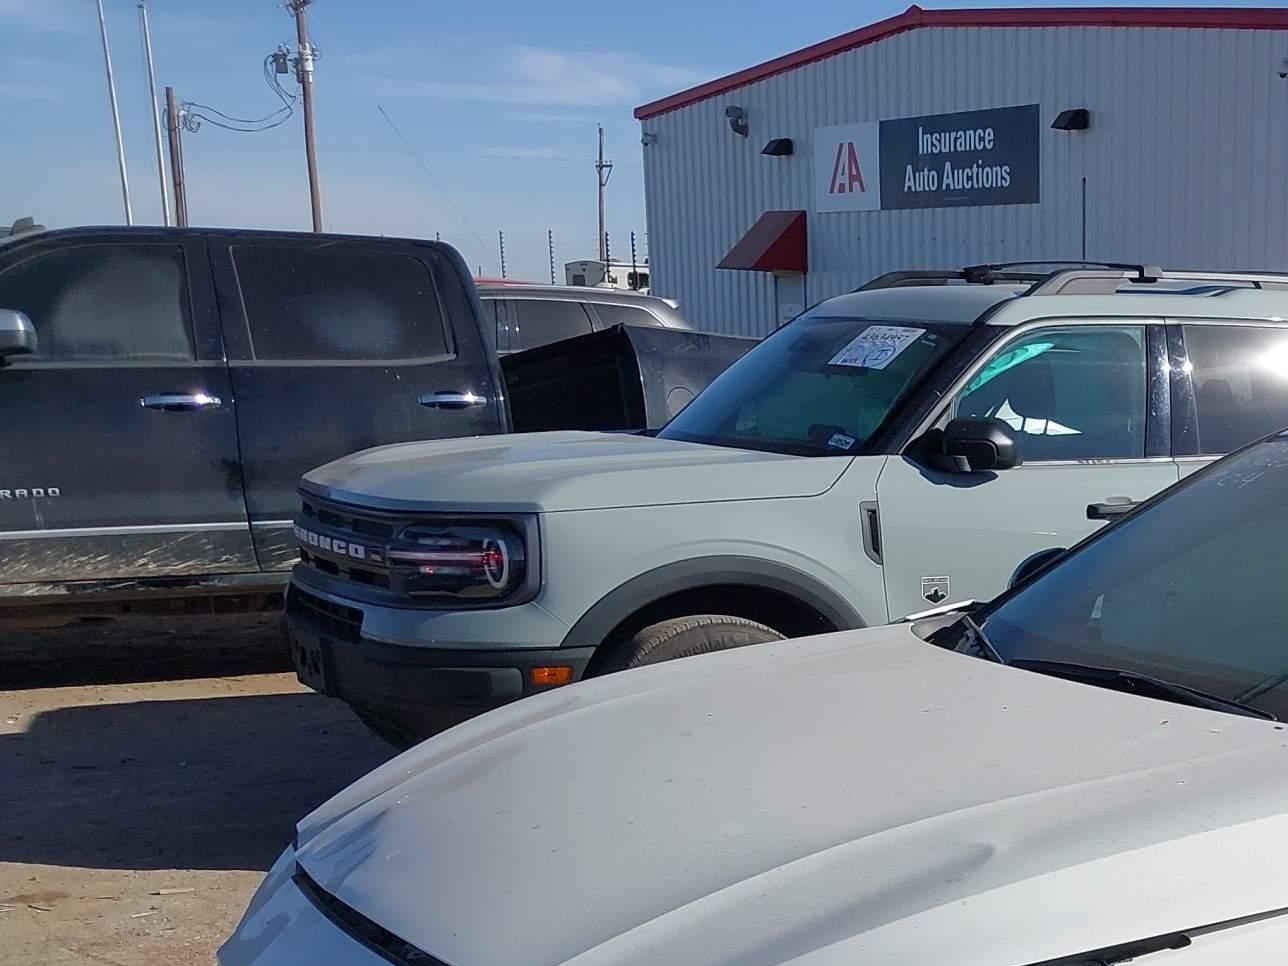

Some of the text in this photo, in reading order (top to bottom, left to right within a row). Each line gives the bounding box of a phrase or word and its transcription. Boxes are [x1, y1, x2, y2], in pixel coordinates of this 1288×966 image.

[918, 126, 994, 155] Insurance
[904, 159, 1010, 193] Auto Auctions
[0, 487, 61, 500] RADO
